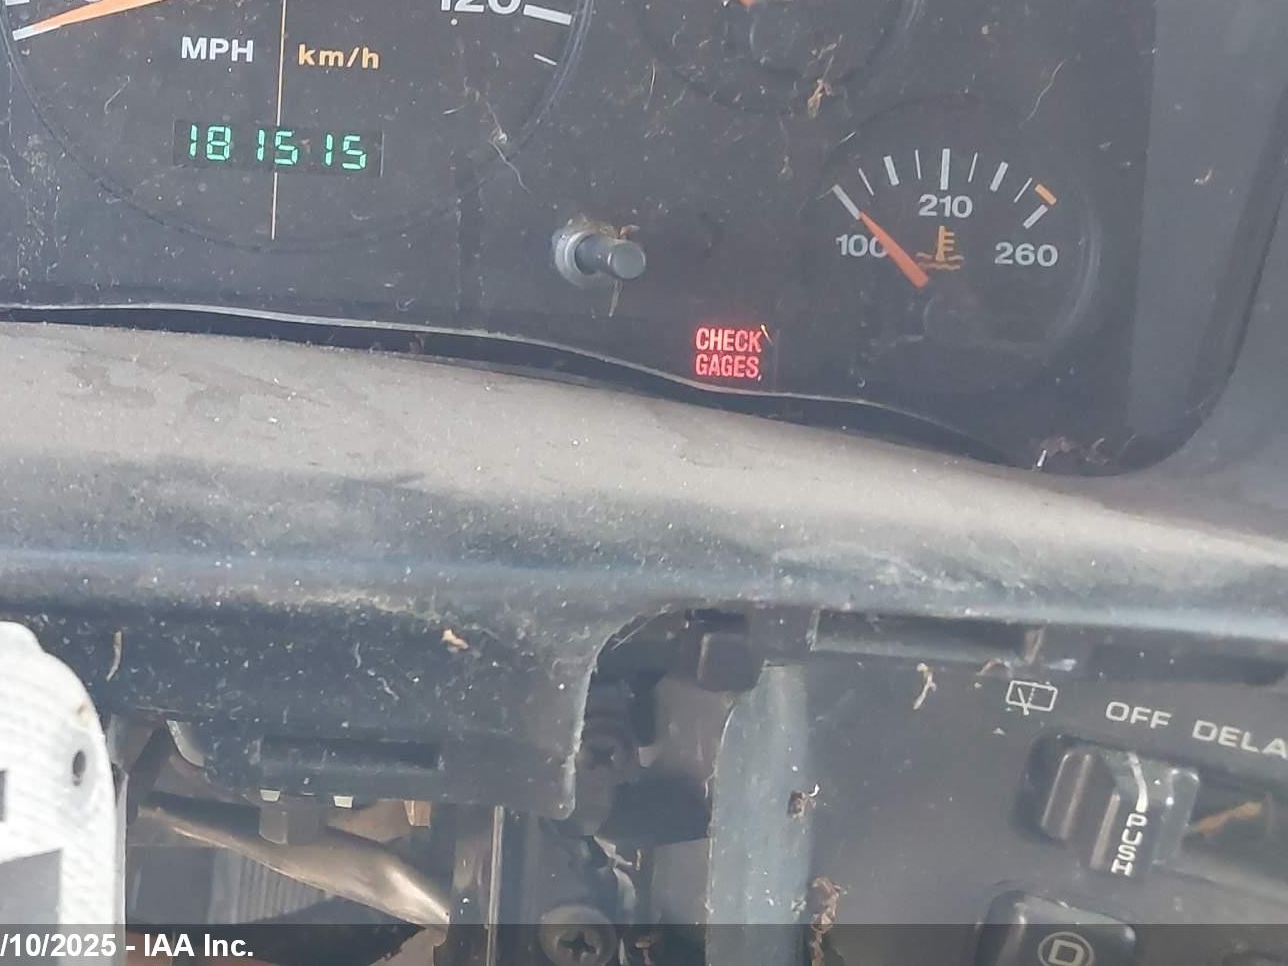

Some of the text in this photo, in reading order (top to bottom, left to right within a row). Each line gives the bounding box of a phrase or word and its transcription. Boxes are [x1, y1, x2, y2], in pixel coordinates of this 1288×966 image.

[180, 37, 254, 63] MPH
[298, 45, 379, 69] km/h
[189, 124, 367, 170] 181515
[918, 194, 973, 219] 210
[835, 234, 889, 259] 100
[994, 242, 1059, 267] 260
[695, 327, 762, 353] CHECK
[695, 353, 760, 379] GAGES
[1105, 701, 1172, 729] OFF
[1111, 812, 1148, 877] PUSH
